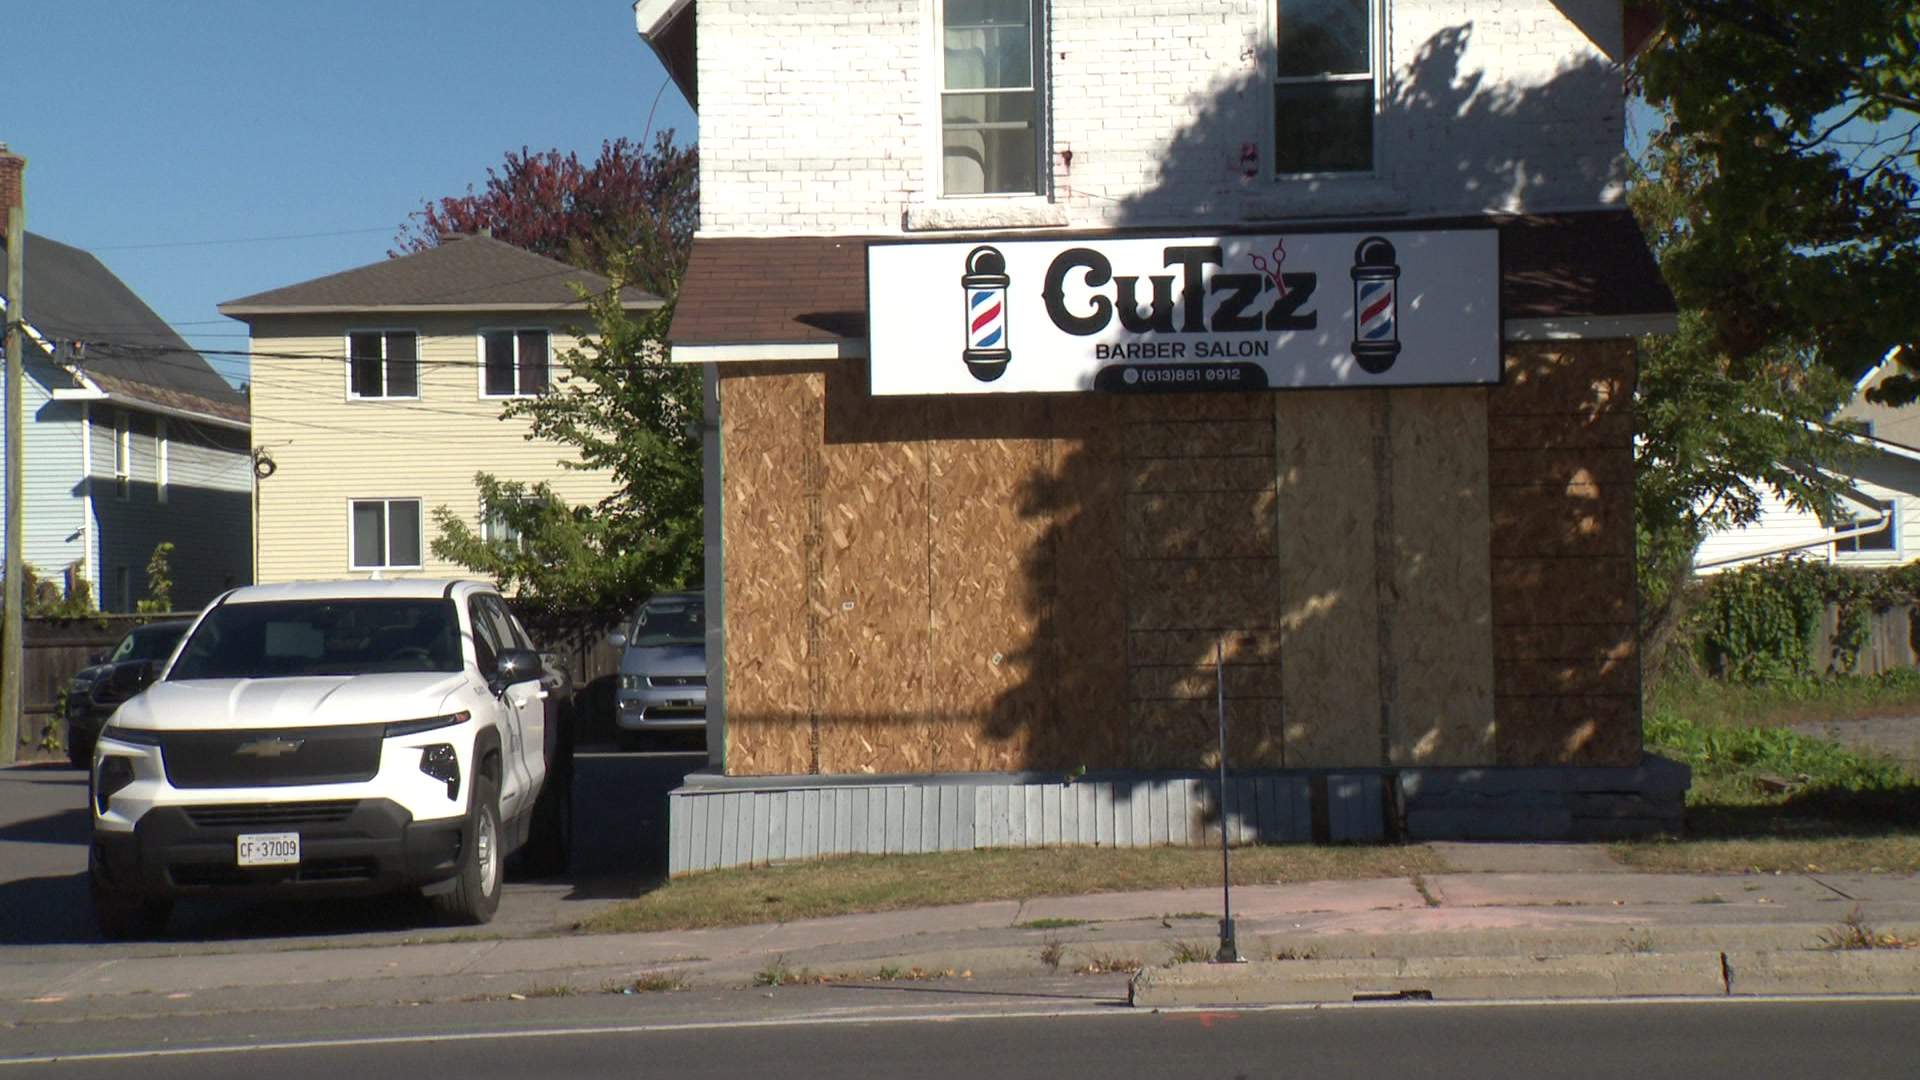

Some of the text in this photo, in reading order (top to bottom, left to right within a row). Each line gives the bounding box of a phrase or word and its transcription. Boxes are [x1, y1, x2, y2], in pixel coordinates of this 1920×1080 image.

[1096, 340, 1268, 360] BARBER SALON
[1205, 368, 1241, 381] 0912
